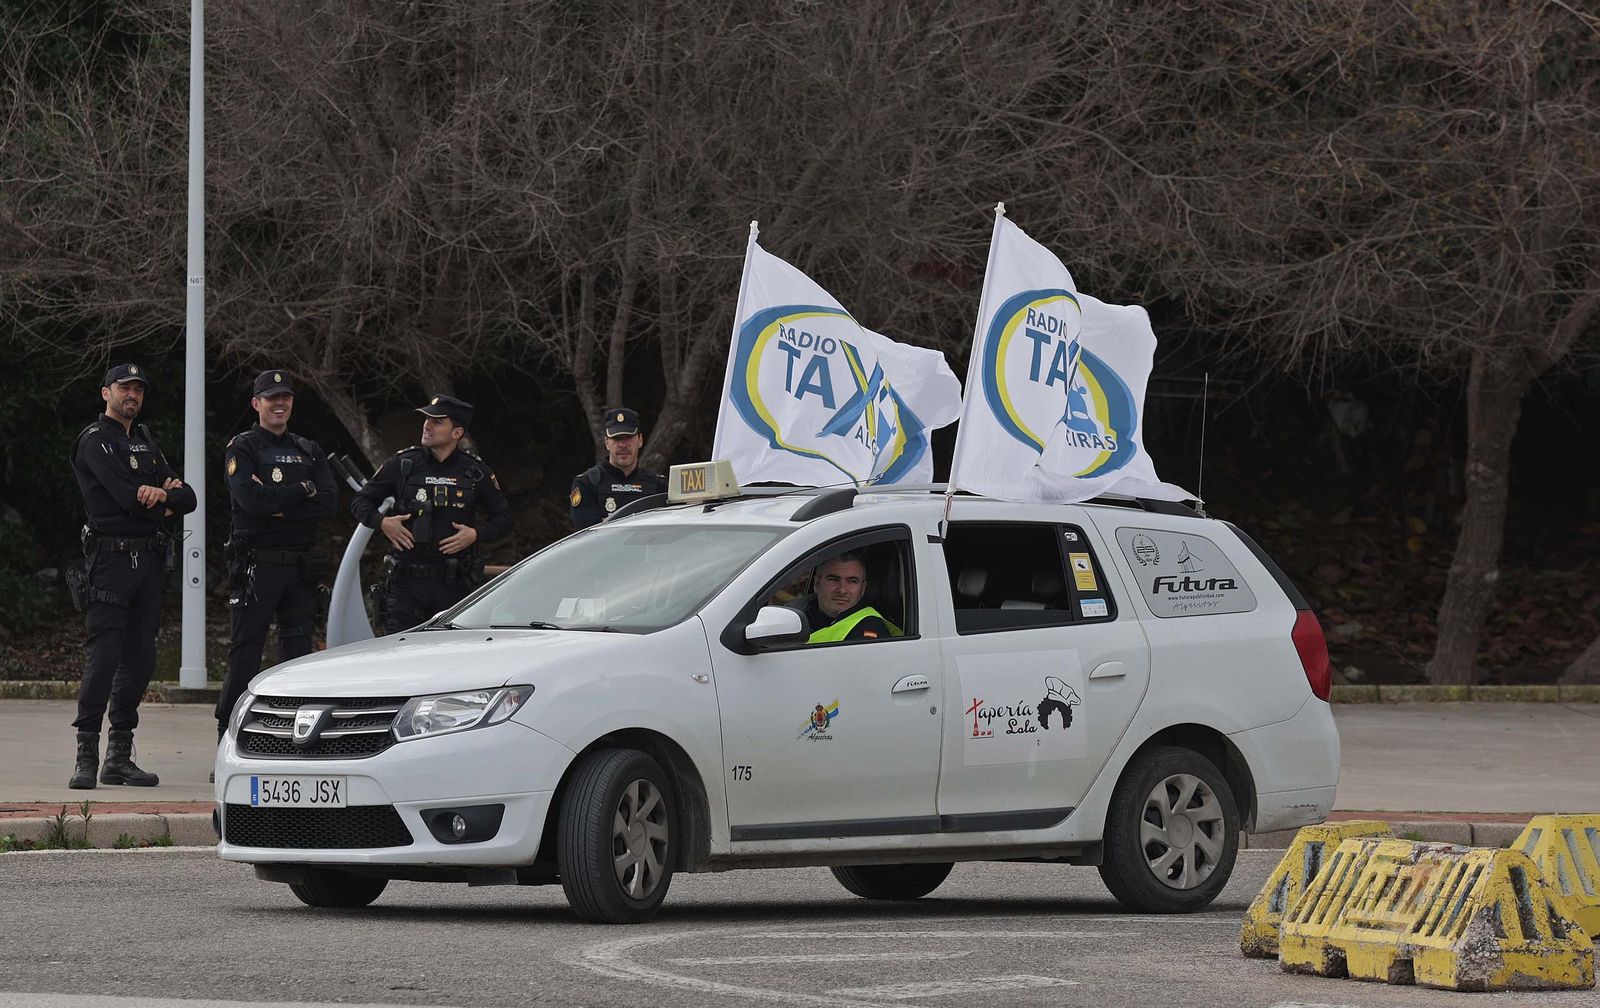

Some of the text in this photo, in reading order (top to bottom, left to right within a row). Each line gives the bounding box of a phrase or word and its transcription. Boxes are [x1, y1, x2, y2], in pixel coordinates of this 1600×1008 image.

[778, 323, 837, 355] RADIO
[681, 469, 705, 492] TAXI
[1152, 575, 1238, 595] Futura
[1005, 718, 1038, 735] Lola
[731, 765, 752, 781] 175
[262, 780, 301, 804] 5436
[309, 780, 340, 804] JSX
